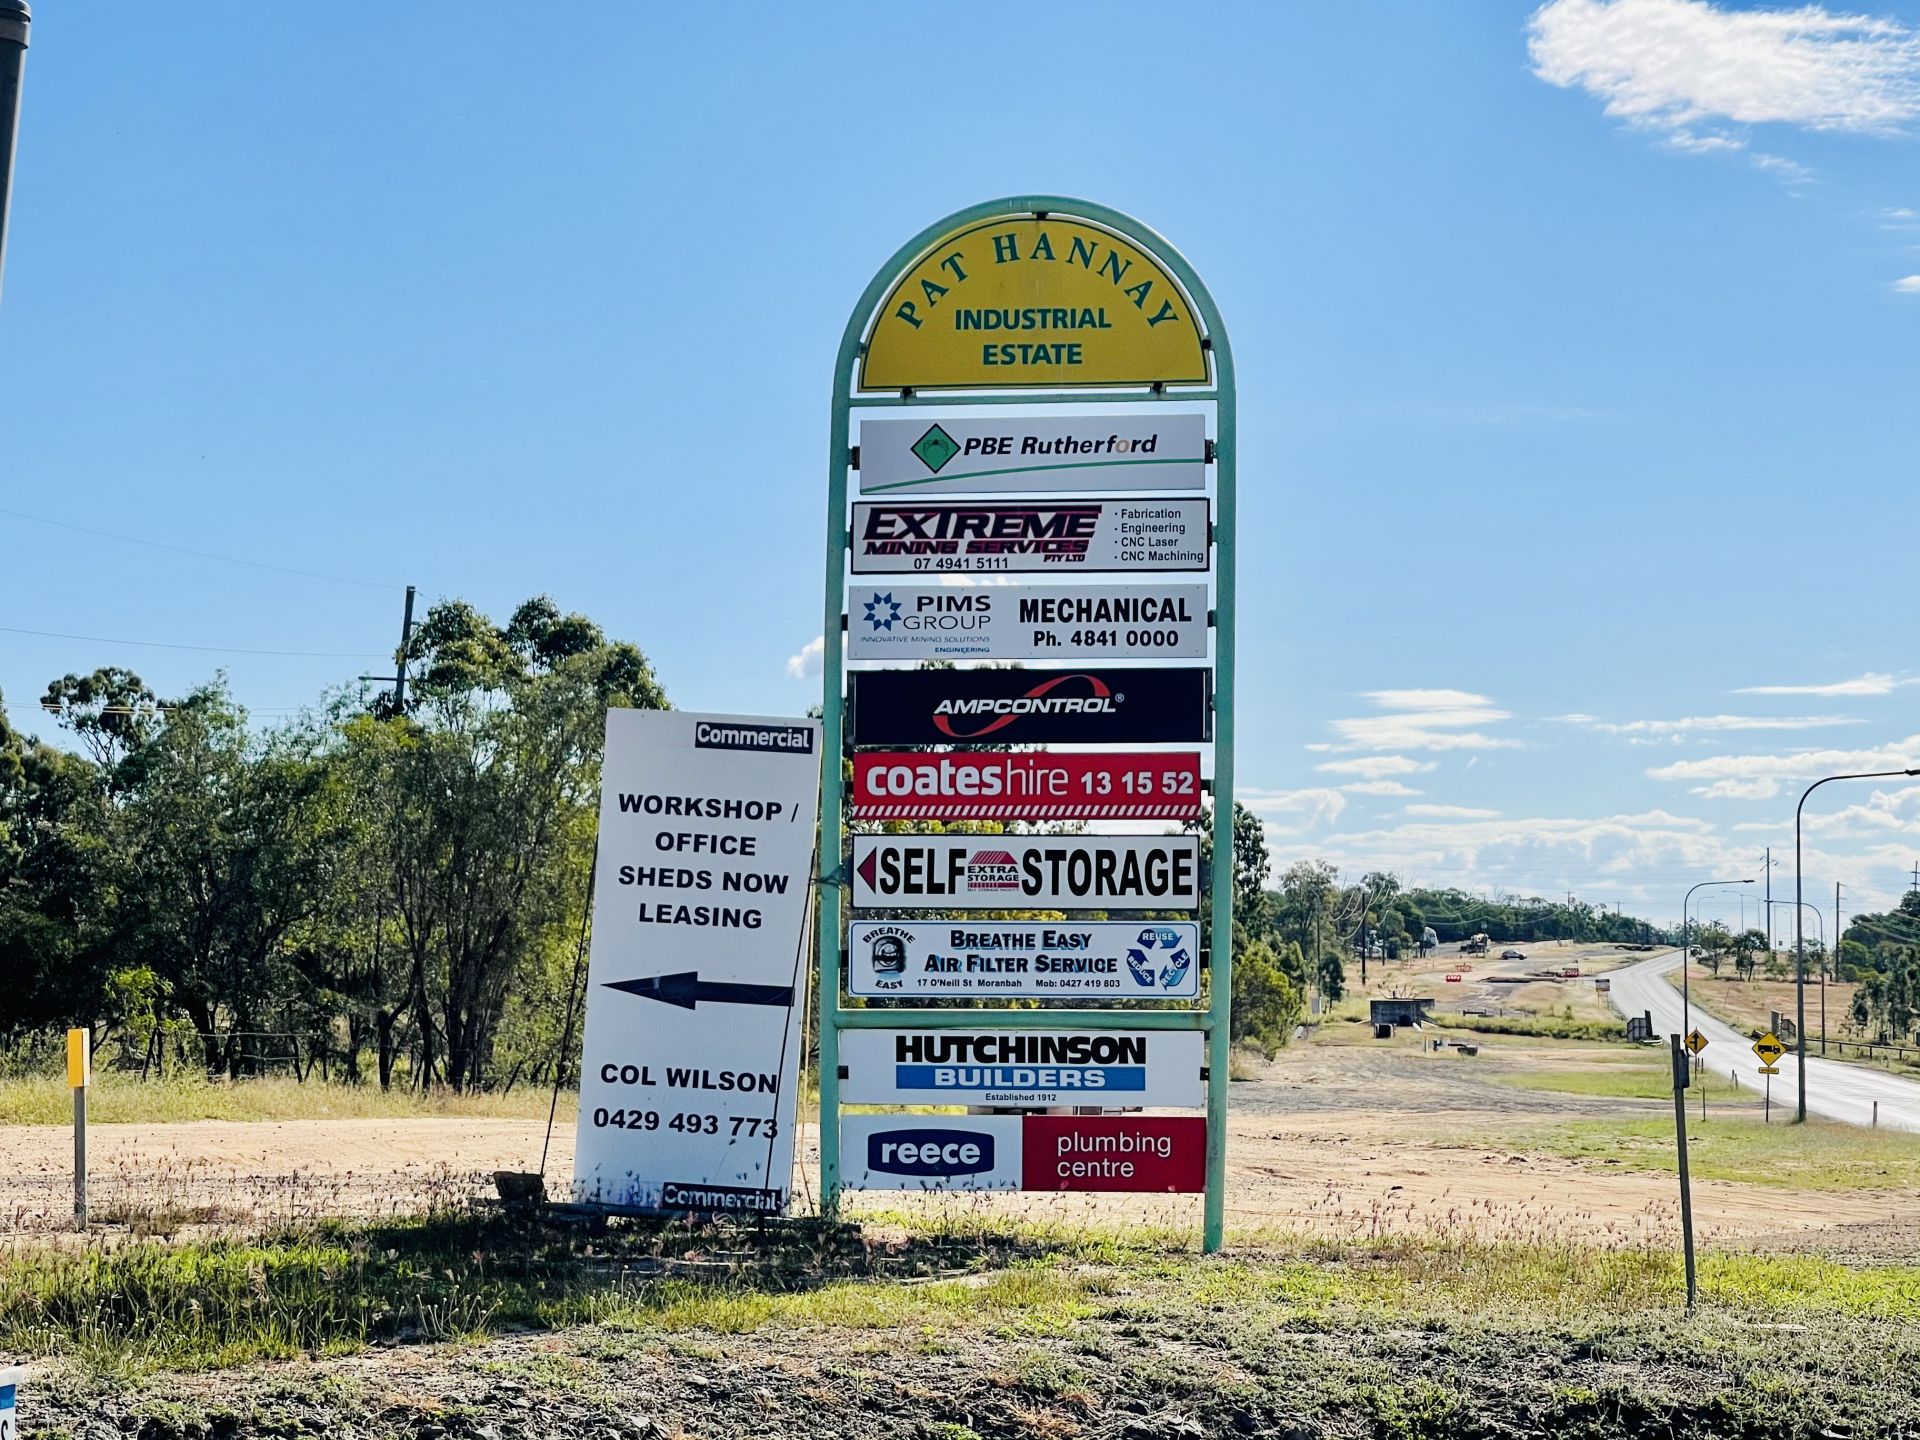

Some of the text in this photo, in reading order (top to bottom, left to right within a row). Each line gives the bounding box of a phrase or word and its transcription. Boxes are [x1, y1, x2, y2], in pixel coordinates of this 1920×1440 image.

[895, 232, 1179, 330] PAT HANNAY
[955, 307, 1112, 330] INDUSTRIAL
[982, 343, 1083, 365] ESTATE
[963, 434, 1158, 456] PBE Rutherford
[862, 505, 1103, 540] EXTREME
[1121, 508, 1181, 519] Fabrication
[1121, 523, 1186, 535] Engineering
[863, 539, 1090, 555] MINING SERVICES
[1121, 537, 1179, 547] CNC Laser
[913, 558, 1009, 569] 07 4941 5111
[1043, 553, 1086, 562] PTY LTD
[1121, 550, 1204, 563] CNC Machining
[916, 595, 991, 612] PIMS
[1019, 598, 1192, 623] MECHANICAL
[903, 616, 991, 630] GROUP
[860, 635, 990, 643] INNOVATIVE MINING SOLUTIONS
[1034, 630, 1179, 647] Ph. 4841 0000
[696, 725, 810, 747] Commercial
[1081, 772, 1112, 795] 13
[1121, 772, 1153, 795] 15
[1161, 772, 1194, 795] 52
[619, 793, 799, 823] WORKSHOP /
[655, 832, 757, 856] OFFICE
[618, 866, 789, 894] SHEDS NOW
[879, 848, 1193, 896] SELF STORAGE
[967, 865, 1019, 873] EXTRA
[967, 874, 1019, 882] STORAGE
[639, 903, 762, 929] LEASING
[862, 927, 916, 944] BREATHE
[1142, 932, 1174, 941] REUSE
[1127, 955, 1153, 984] REDUCE
[1160, 951, 1190, 986] RECYCLE
[875, 980, 903, 990] EASY
[917, 979, 1121, 988] 17 O'Neill St Moranbah Mob: 0427 419 803
[896, 1035, 1146, 1064] HUTCHINSON
[601, 1064, 778, 1094] COL WILSON
[934, 1068, 1106, 1088] BUILDERS
[985, 1093, 1057, 1102] Established 1912
[593, 1108, 778, 1139] 0429 493 773
[881, 1142, 981, 1164] reece
[1057, 1132, 1172, 1157] plumbing
[1057, 1159, 1134, 1177] centre
[665, 1185, 777, 1211] Commercial
